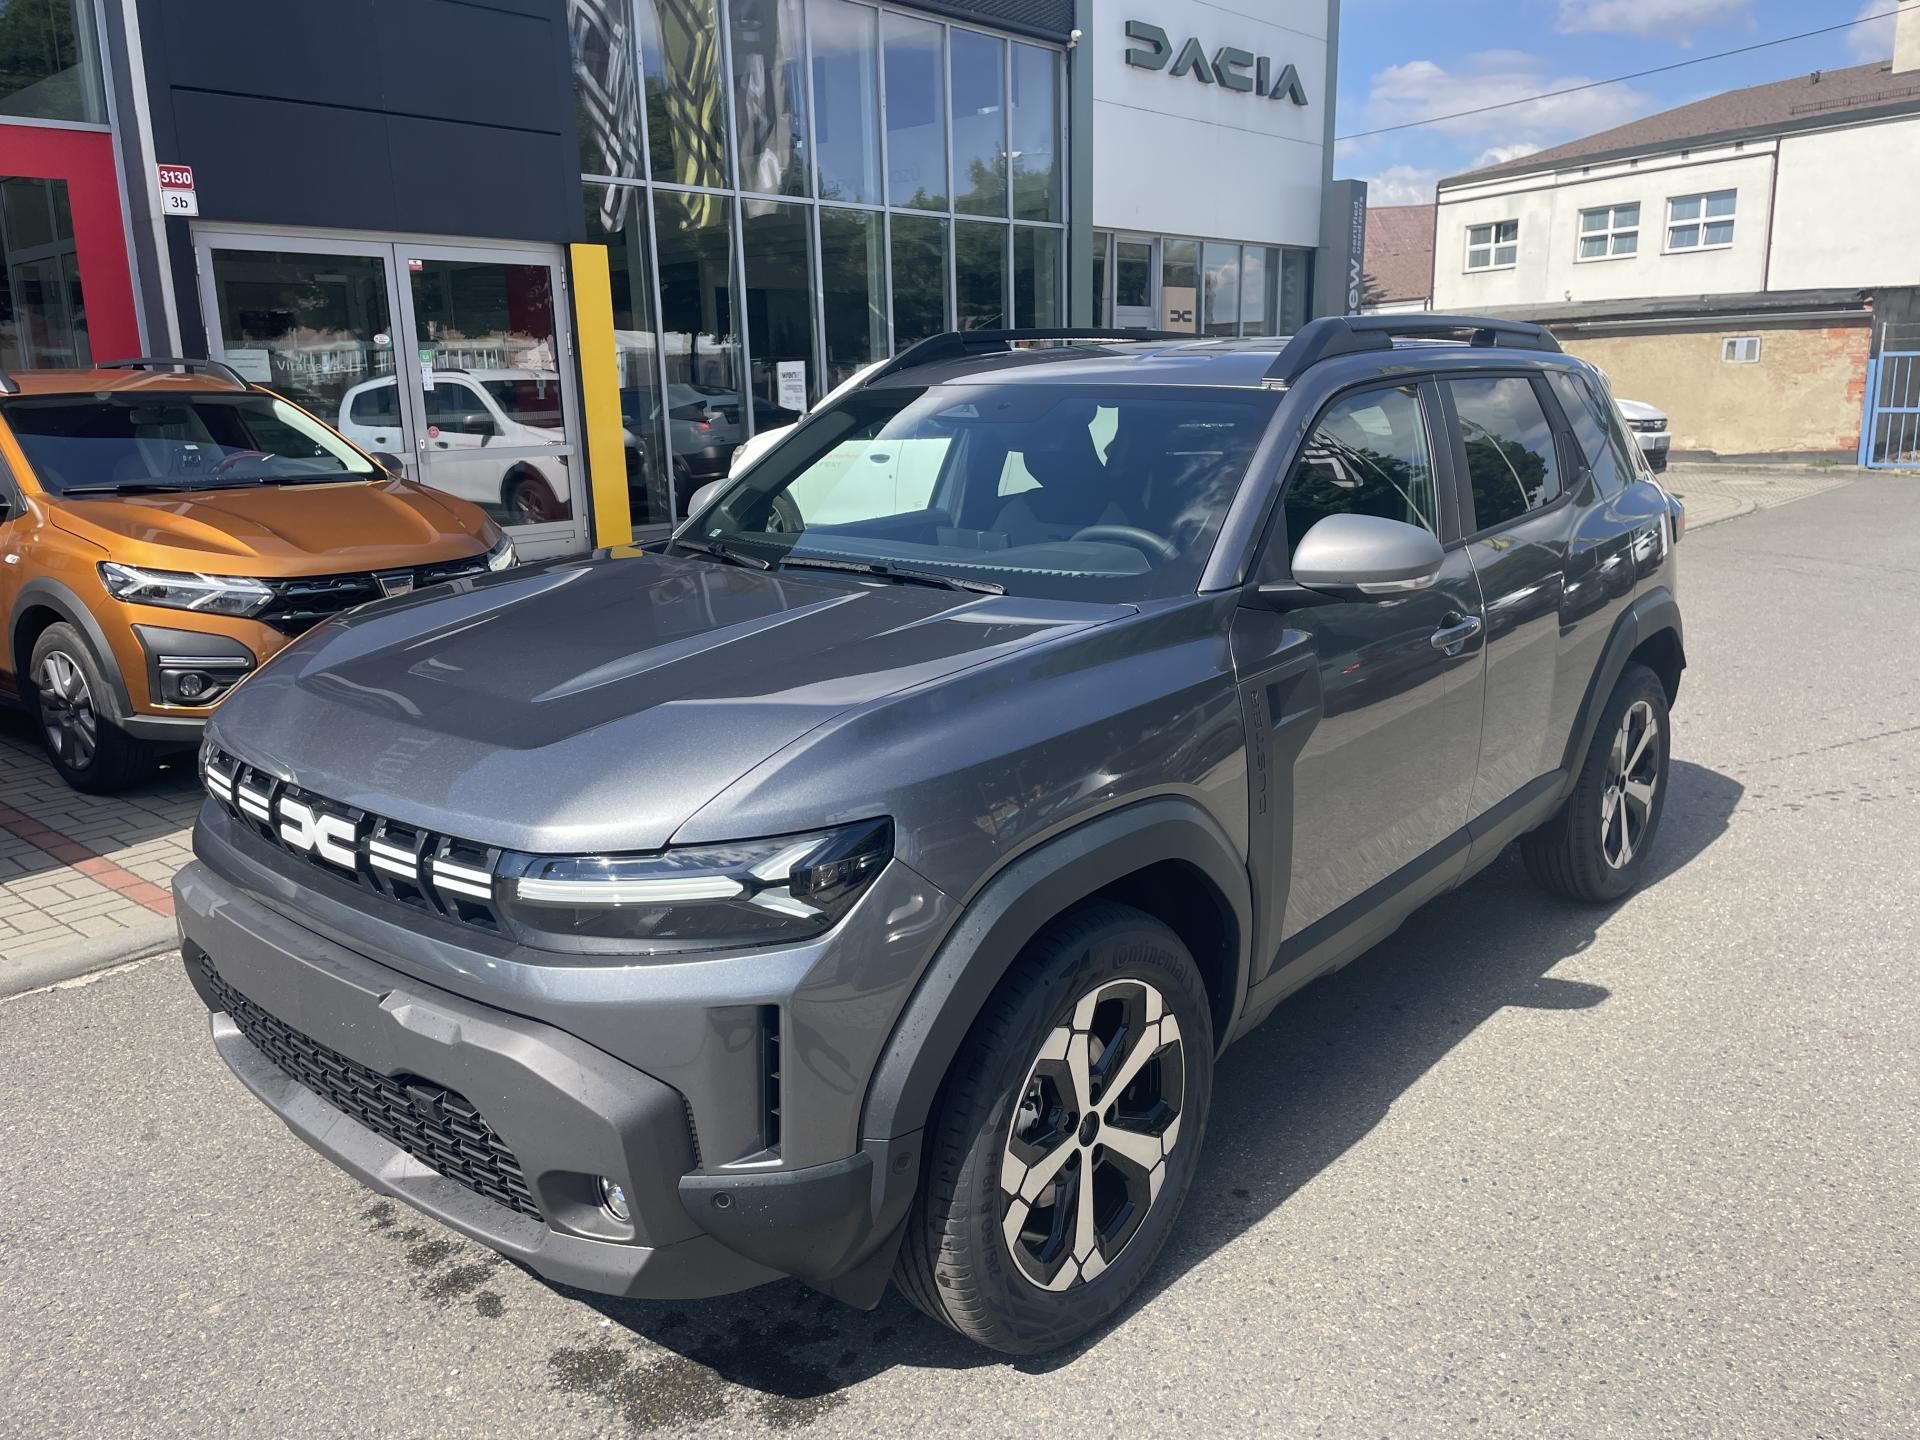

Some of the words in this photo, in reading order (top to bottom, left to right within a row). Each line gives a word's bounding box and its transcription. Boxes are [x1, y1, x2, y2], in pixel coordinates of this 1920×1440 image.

[1125, 20, 1309, 105] DACIA
[160, 170, 192, 185] 3130
[171, 196, 189, 208] 3b
[1251, 688, 1267, 816] DUSTER
